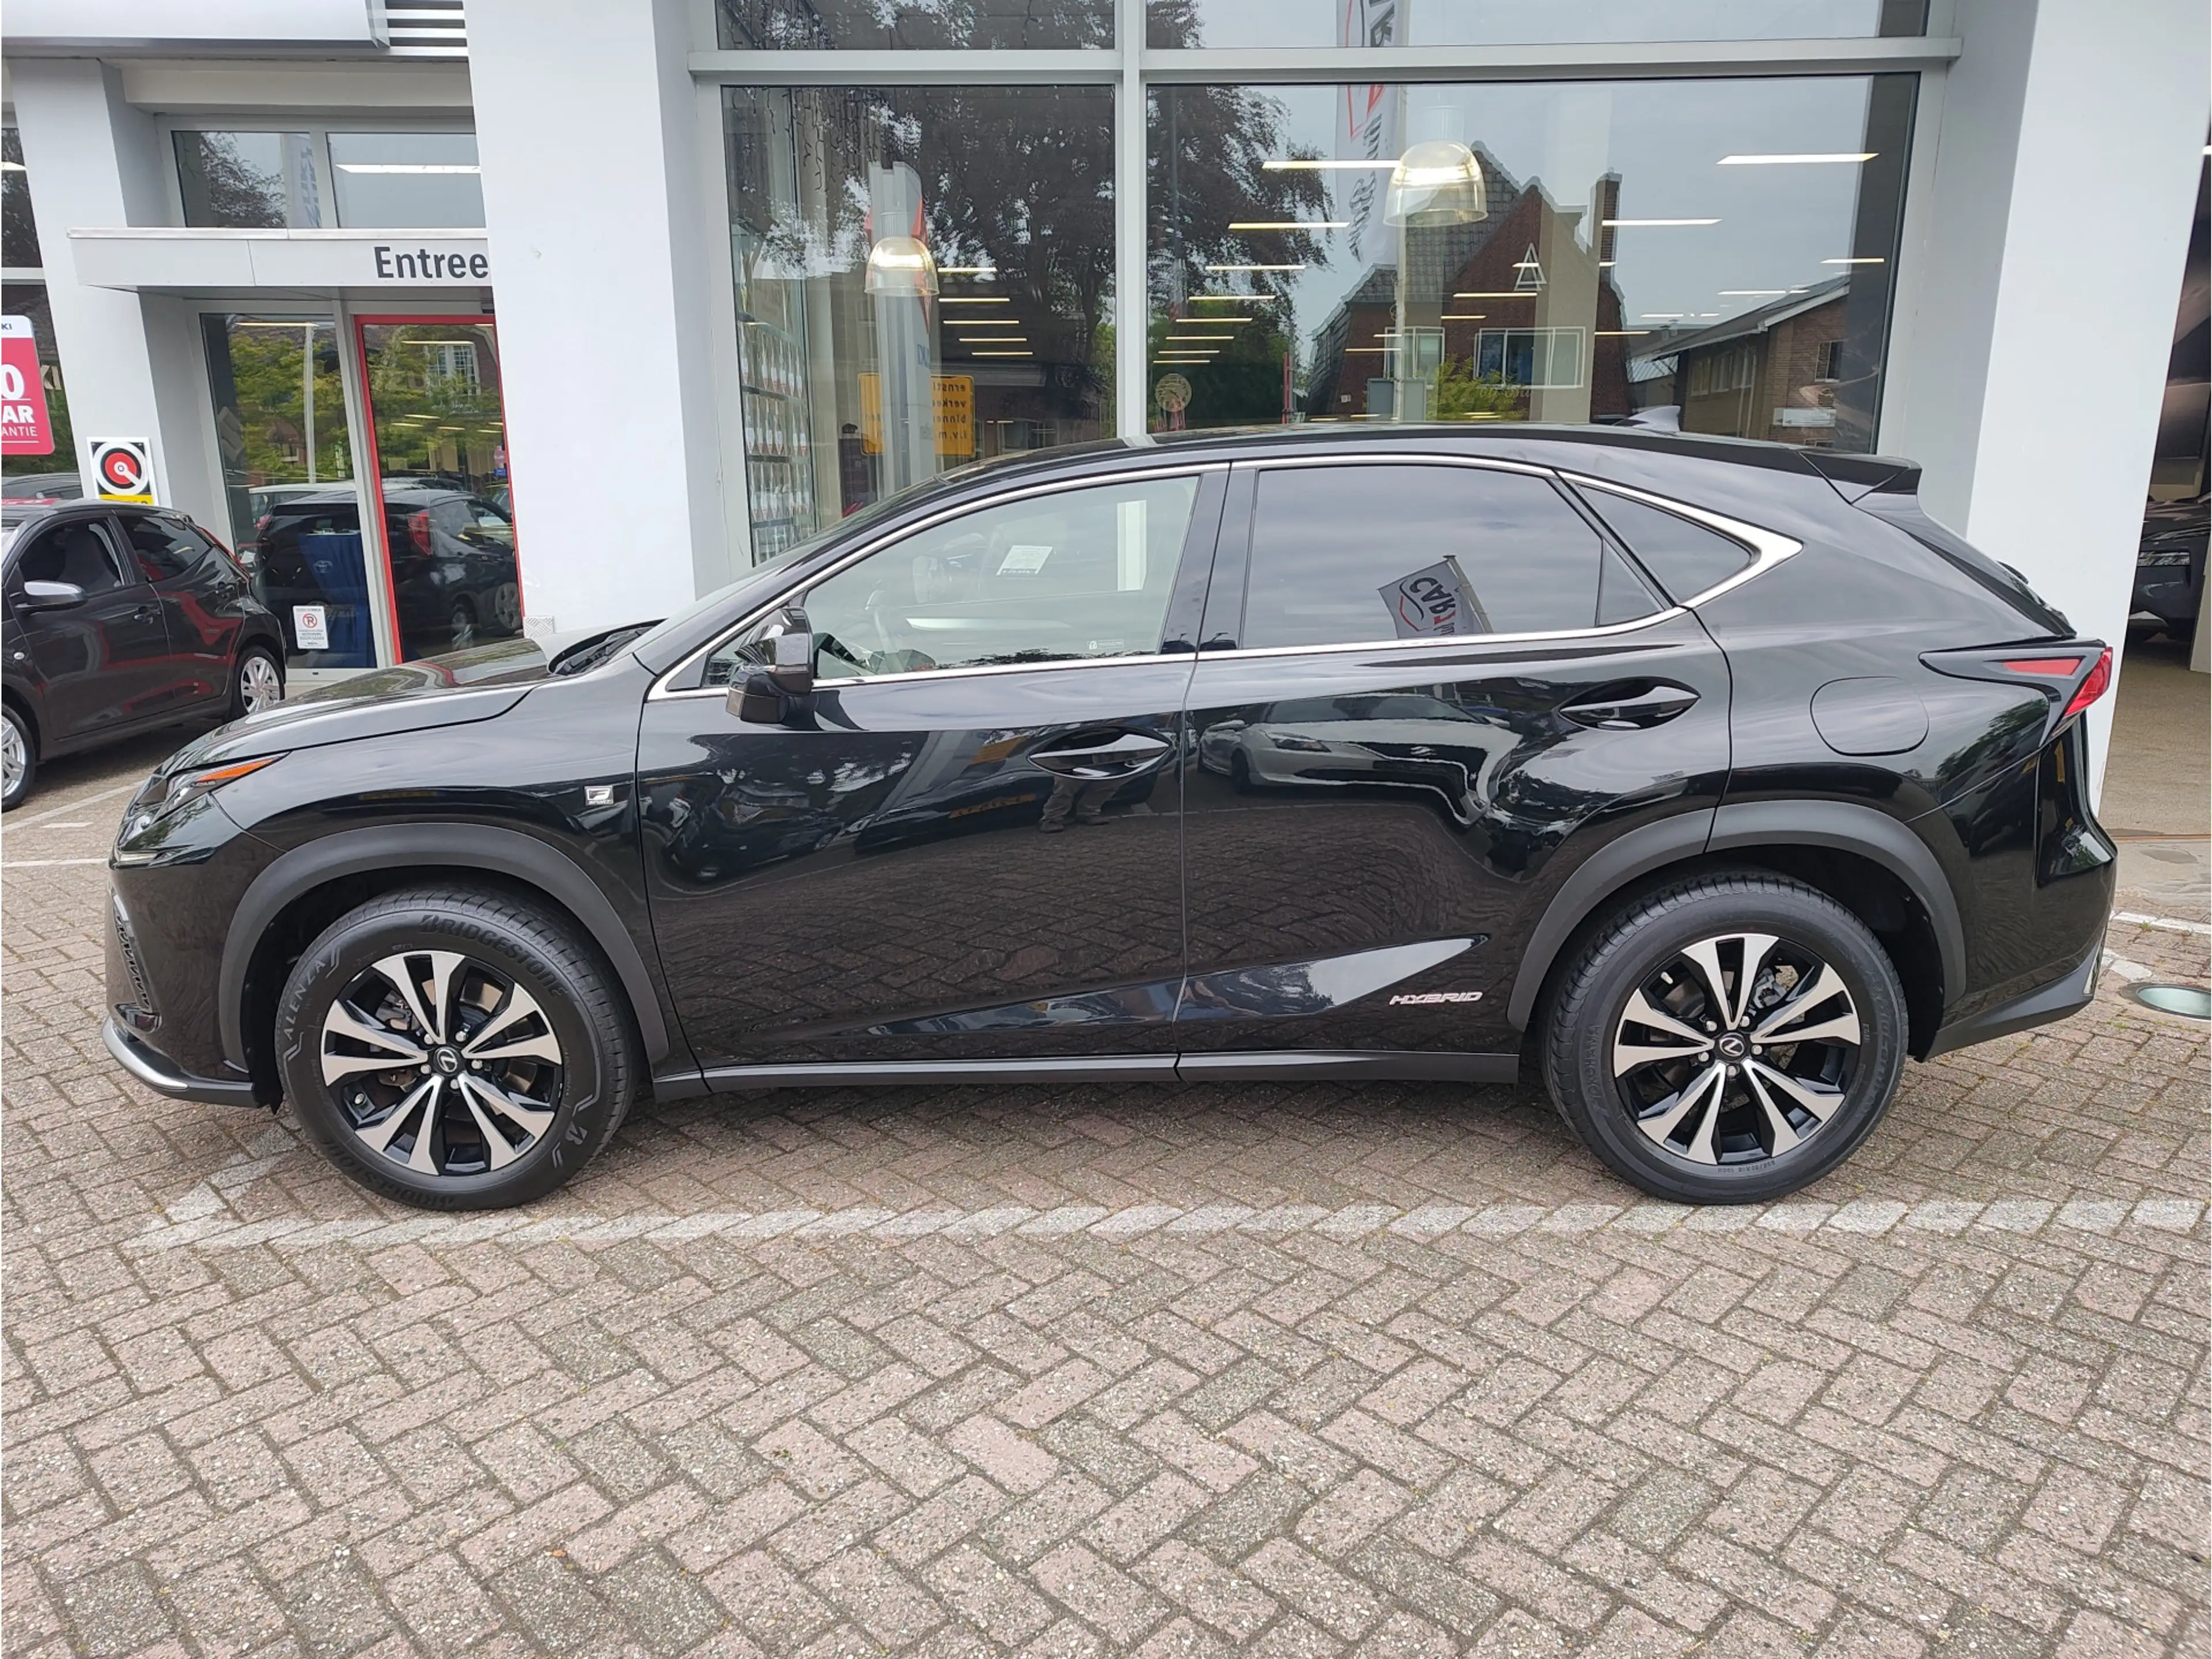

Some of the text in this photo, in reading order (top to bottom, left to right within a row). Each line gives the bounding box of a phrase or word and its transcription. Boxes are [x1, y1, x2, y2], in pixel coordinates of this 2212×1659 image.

[374, 247, 488, 279] Entree
[419, 914, 568, 998] BRIDGESTONE
[283, 960, 326, 1041] ALENZA
[1389, 986, 1483, 1006] HYBRID
